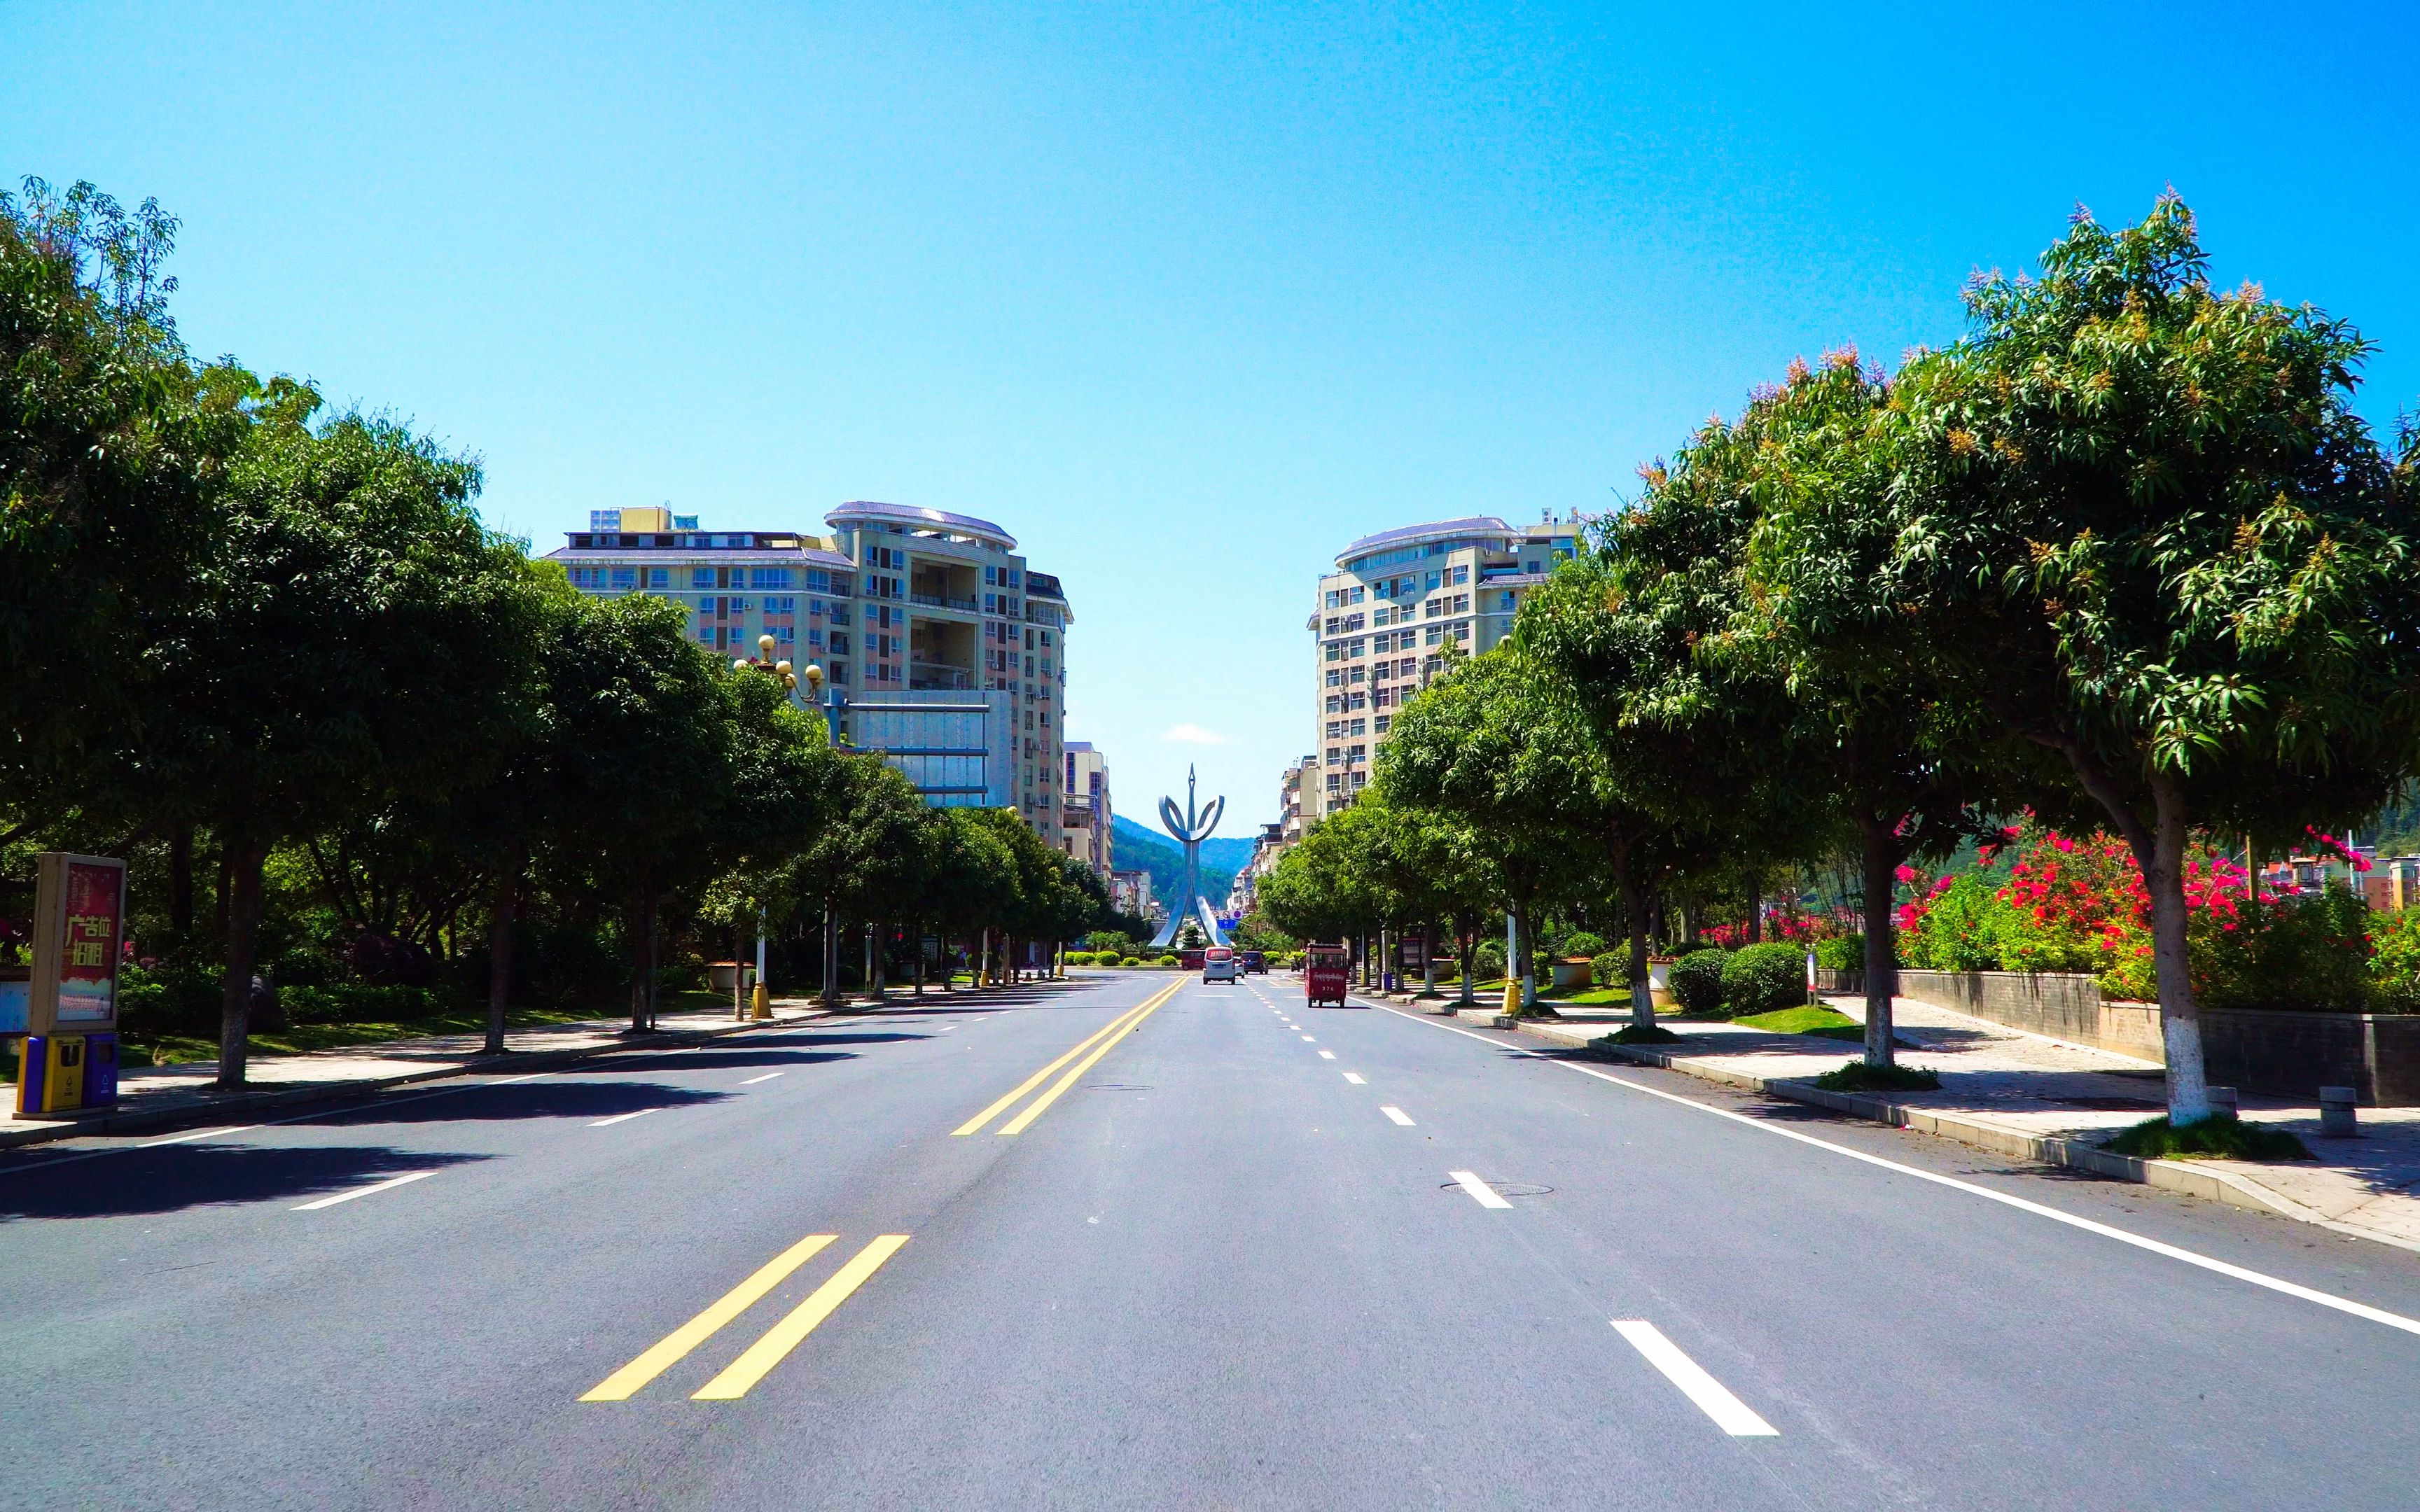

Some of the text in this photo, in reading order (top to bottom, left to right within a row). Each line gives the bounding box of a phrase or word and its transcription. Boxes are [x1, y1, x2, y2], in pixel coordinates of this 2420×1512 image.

[66, 914, 111, 946] 广告位
[72, 939, 104, 966] 招租
